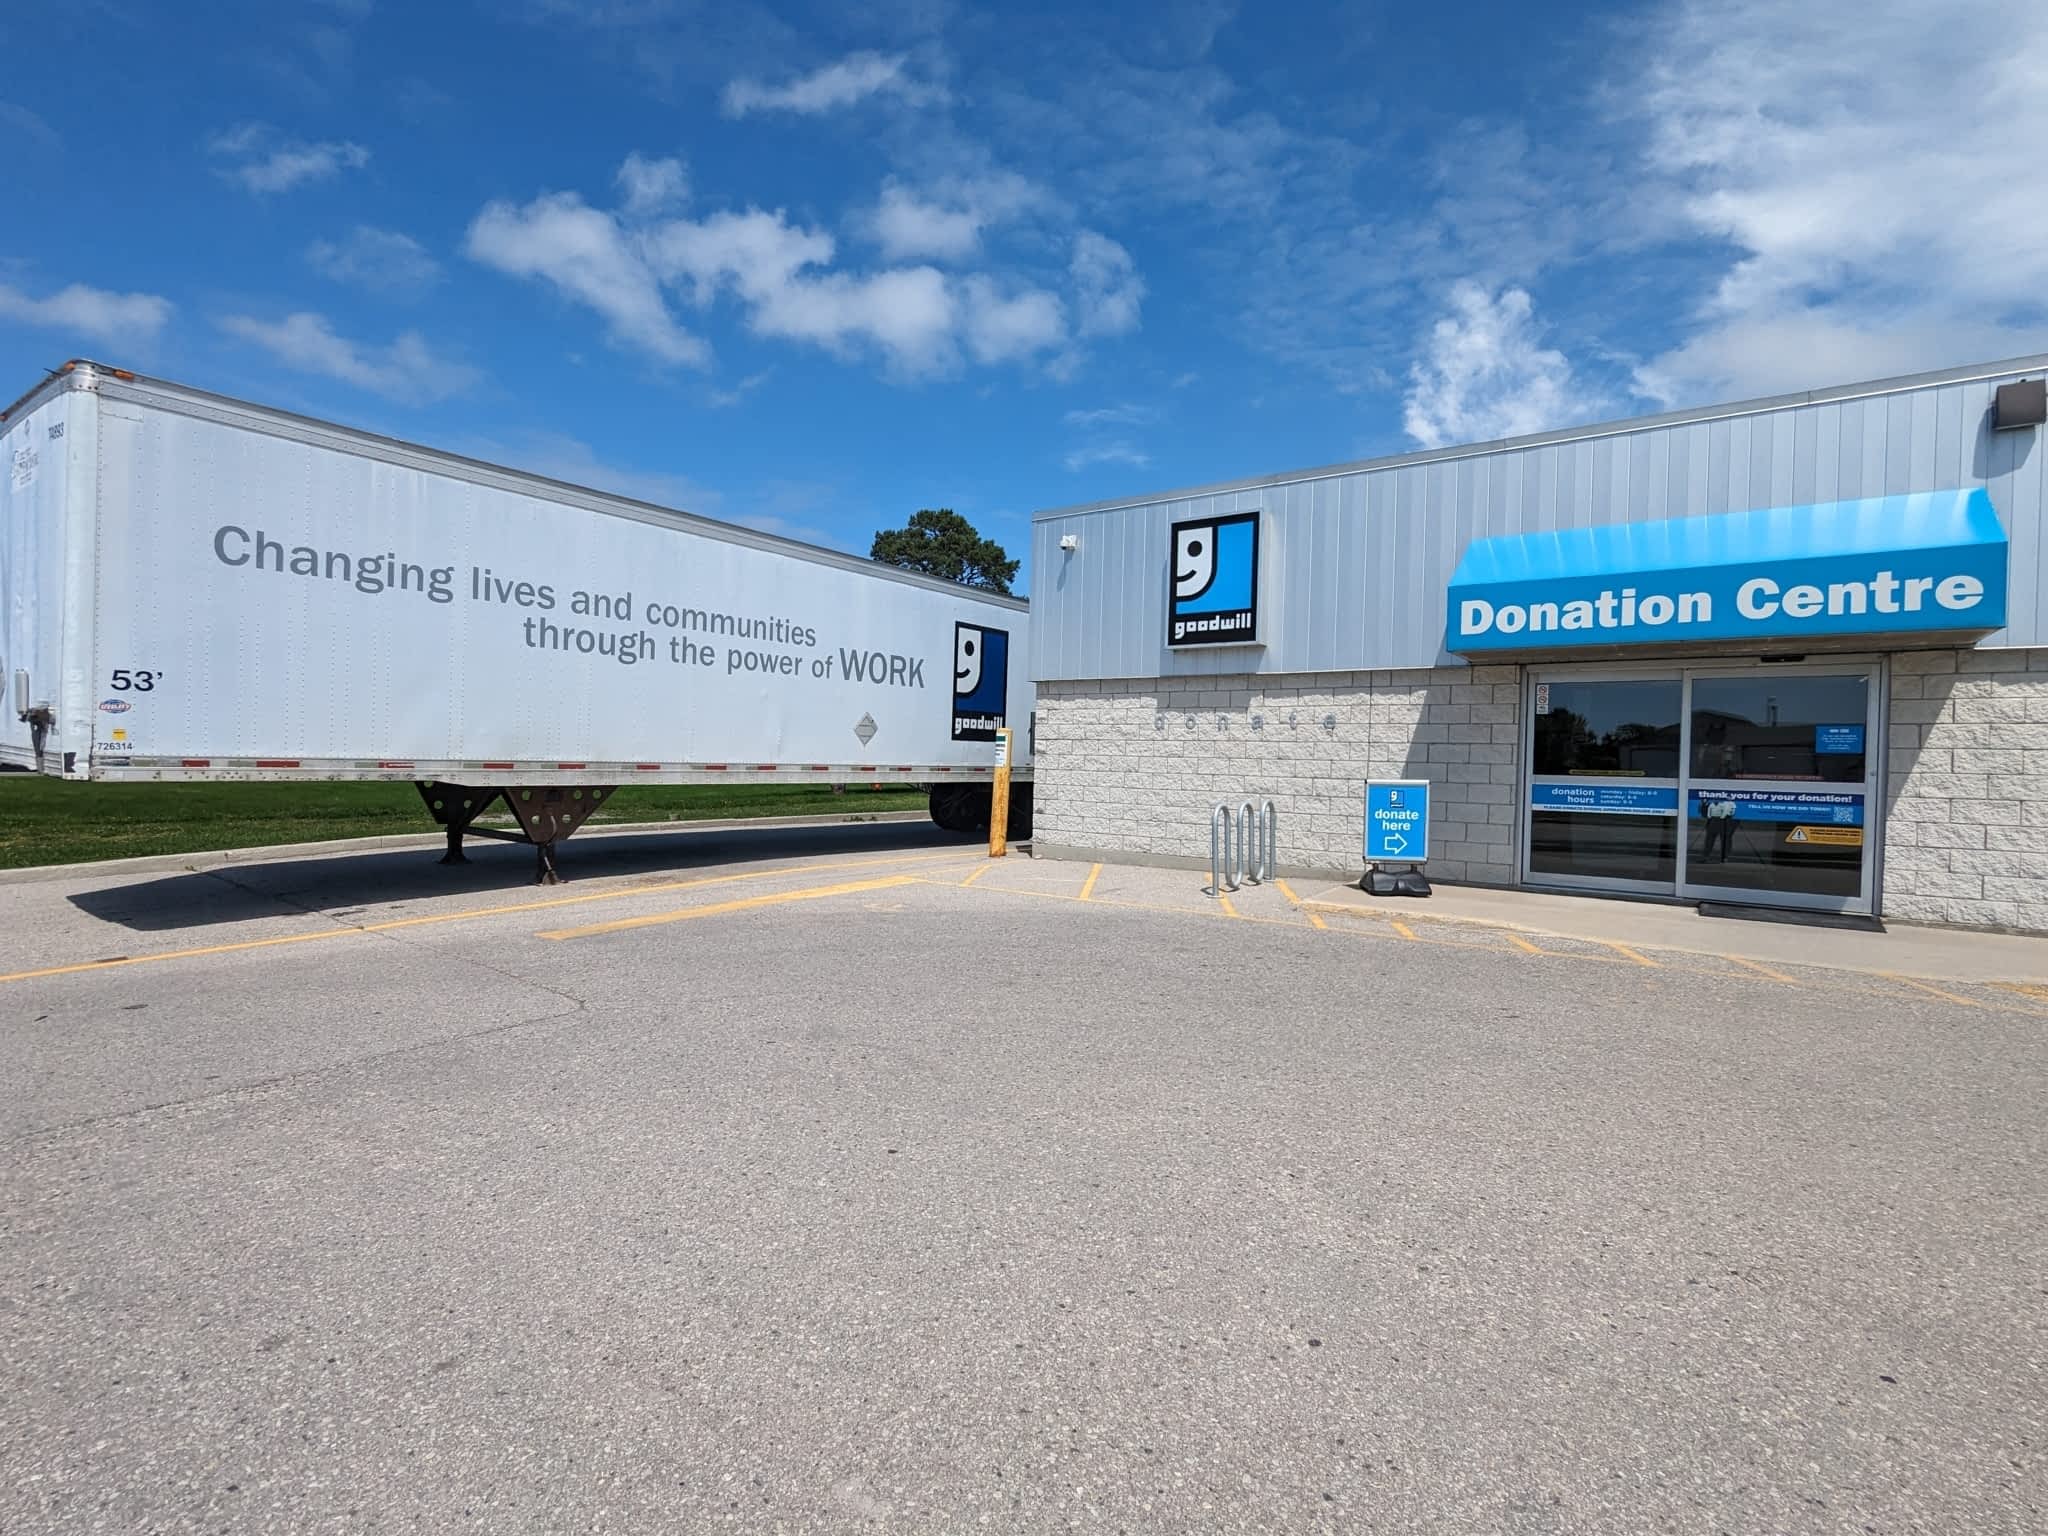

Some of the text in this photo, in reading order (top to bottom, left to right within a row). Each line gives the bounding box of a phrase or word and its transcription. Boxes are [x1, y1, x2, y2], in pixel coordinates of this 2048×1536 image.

[214, 525, 817, 647] Changing lives and communities
[1460, 571, 1985, 636] Donation Centre
[1174, 613, 1252, 640] goodwill
[523, 616, 925, 689] through the power of WORK
[955, 715, 1003, 735] goodwill
[97, 742, 133, 751] 726314
[1551, 788, 1595, 796] donation
[1698, 791, 1853, 803] thank you for your donation!
[1567, 795, 1595, 804] hours
[1374, 808, 1420, 820] donate
[1382, 820, 1411, 831] here
